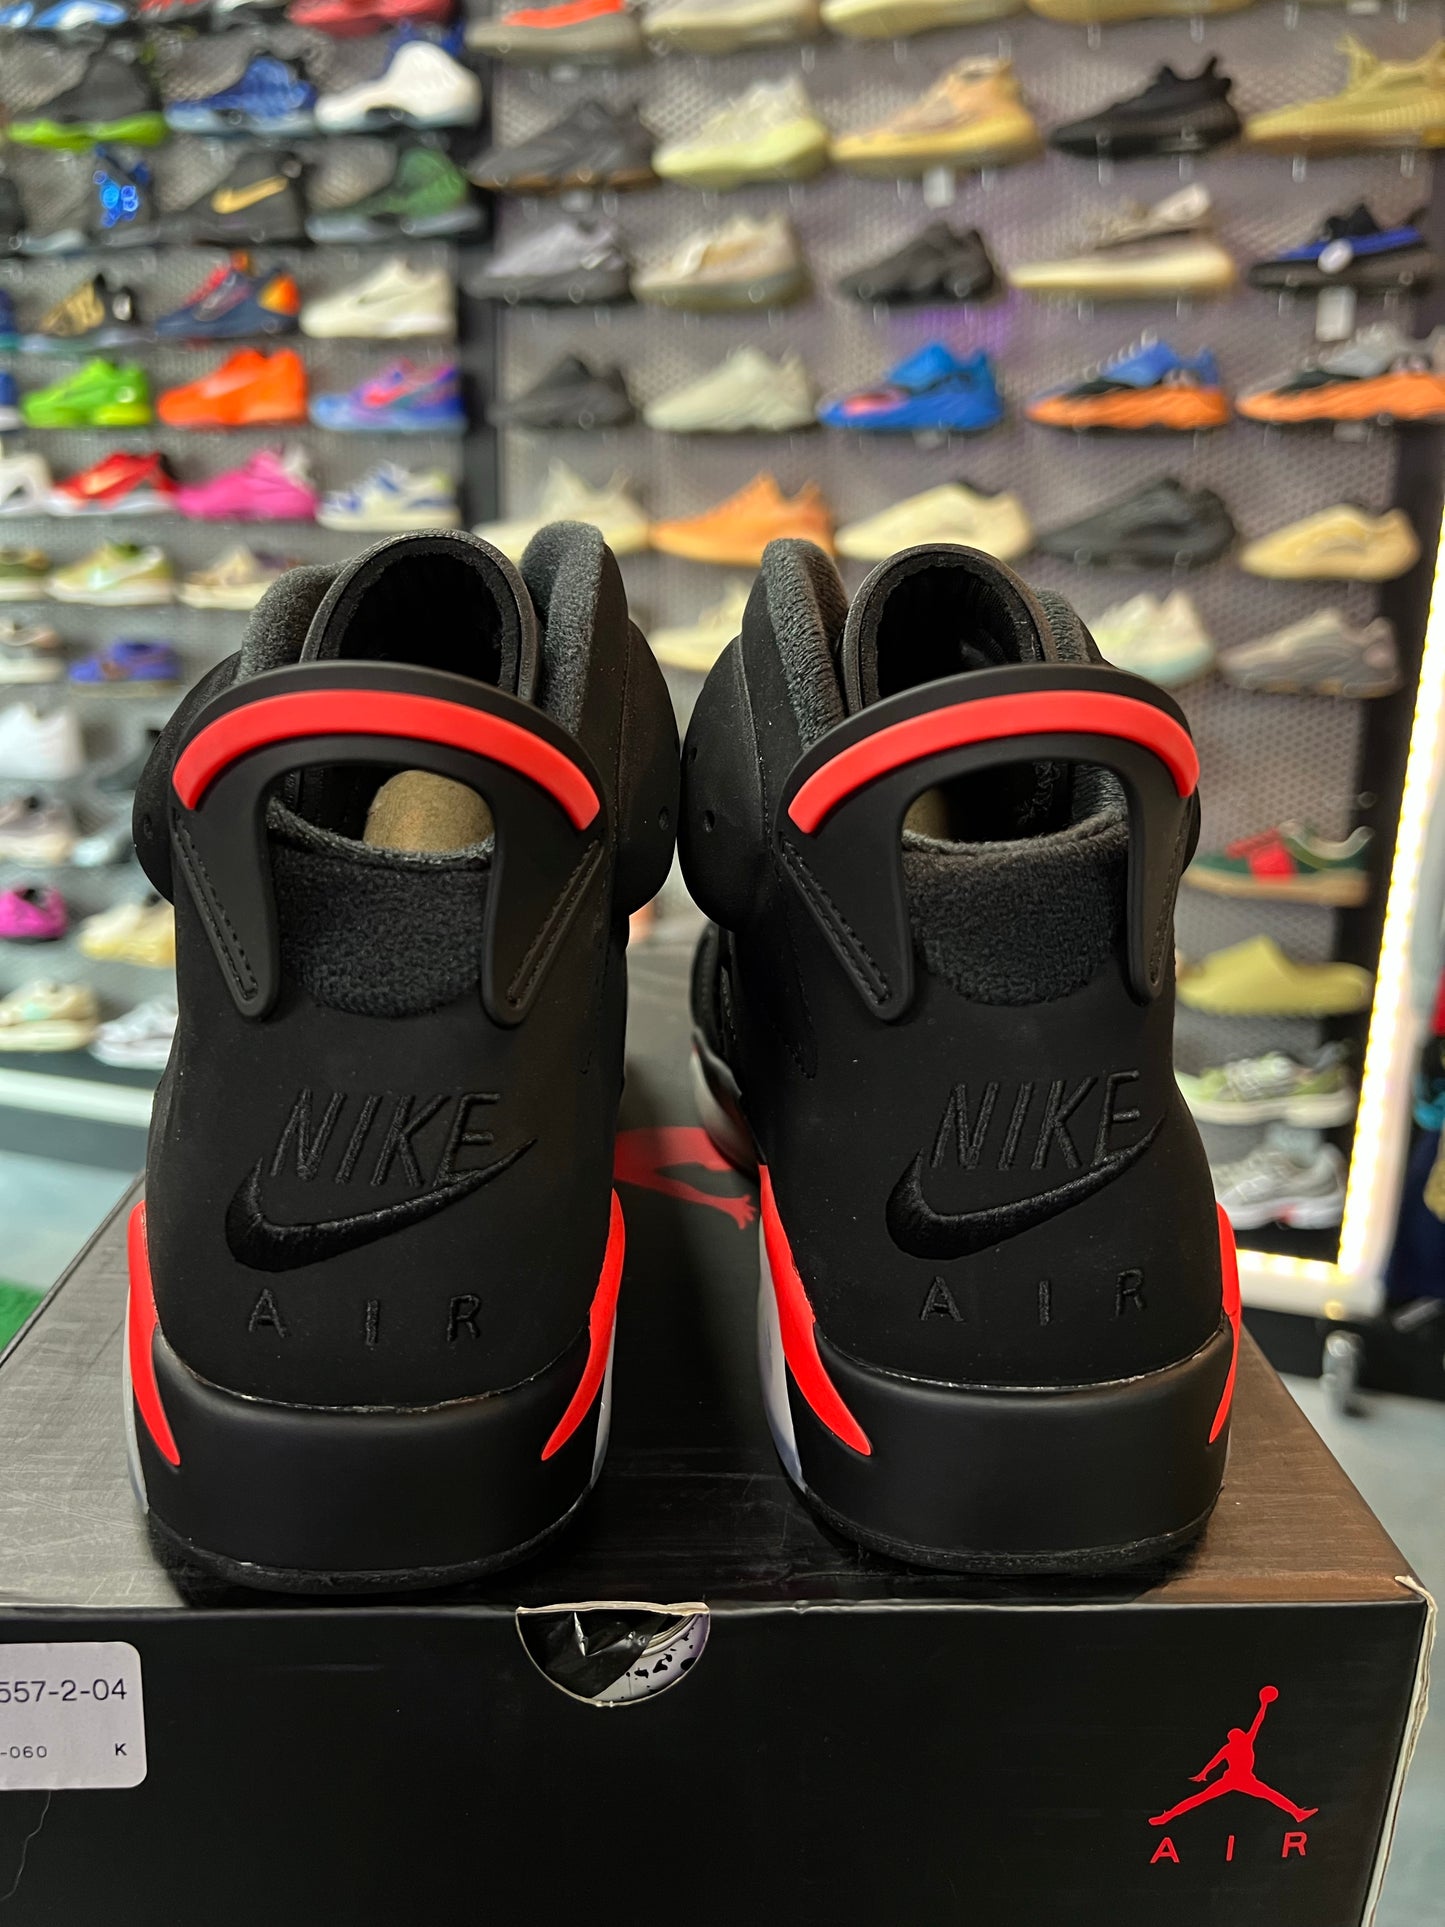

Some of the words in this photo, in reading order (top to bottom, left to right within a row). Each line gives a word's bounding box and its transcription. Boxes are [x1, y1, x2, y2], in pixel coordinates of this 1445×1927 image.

[269, 1087, 501, 1187] NIKE
[930, 1070, 1140, 1170] NIKE
[248, 1287, 482, 1347] AIR
[919, 1268, 1145, 1326] AIR
[114, 1743, 128, 1757] K
[1149, 1831, 1308, 1864] AIR
